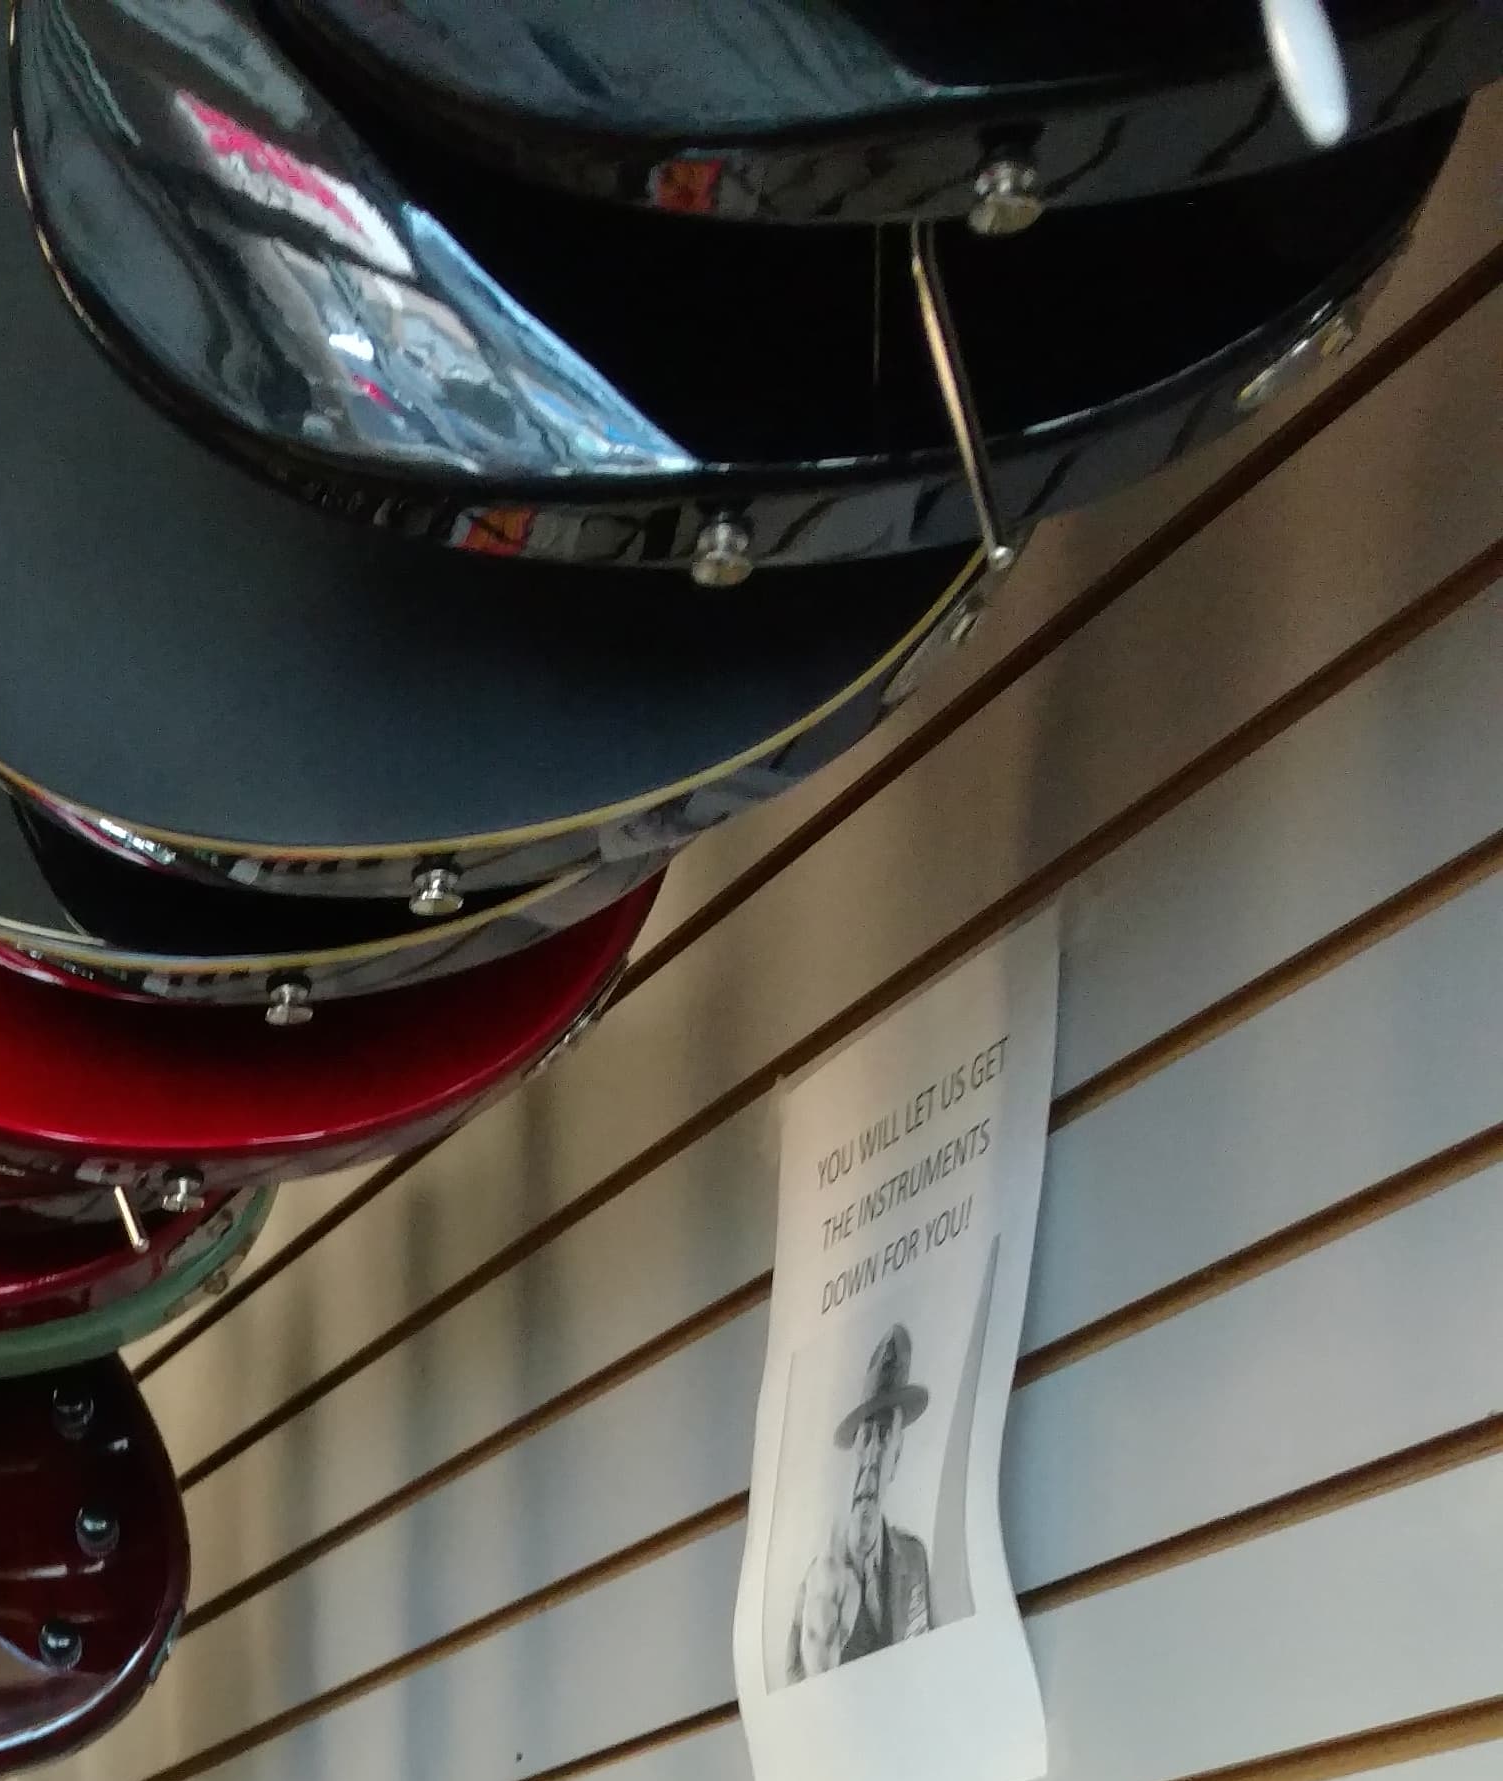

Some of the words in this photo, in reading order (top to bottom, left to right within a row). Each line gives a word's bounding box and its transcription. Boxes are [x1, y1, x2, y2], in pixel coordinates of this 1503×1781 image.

[817, 1138, 855, 1190] YOU
[858, 1108, 900, 1166] WILL
[904, 1083, 937, 1135] LET
[941, 1063, 966, 1111] US
[970, 1033, 1011, 1090] GET
[821, 1202, 856, 1251] THE
[857, 1118, 991, 1230] INSTRUMENTS
[821, 1253, 879, 1316] DOWN
[881, 1227, 921, 1281] FOR
[924, 1192, 974, 1254] YOU!
